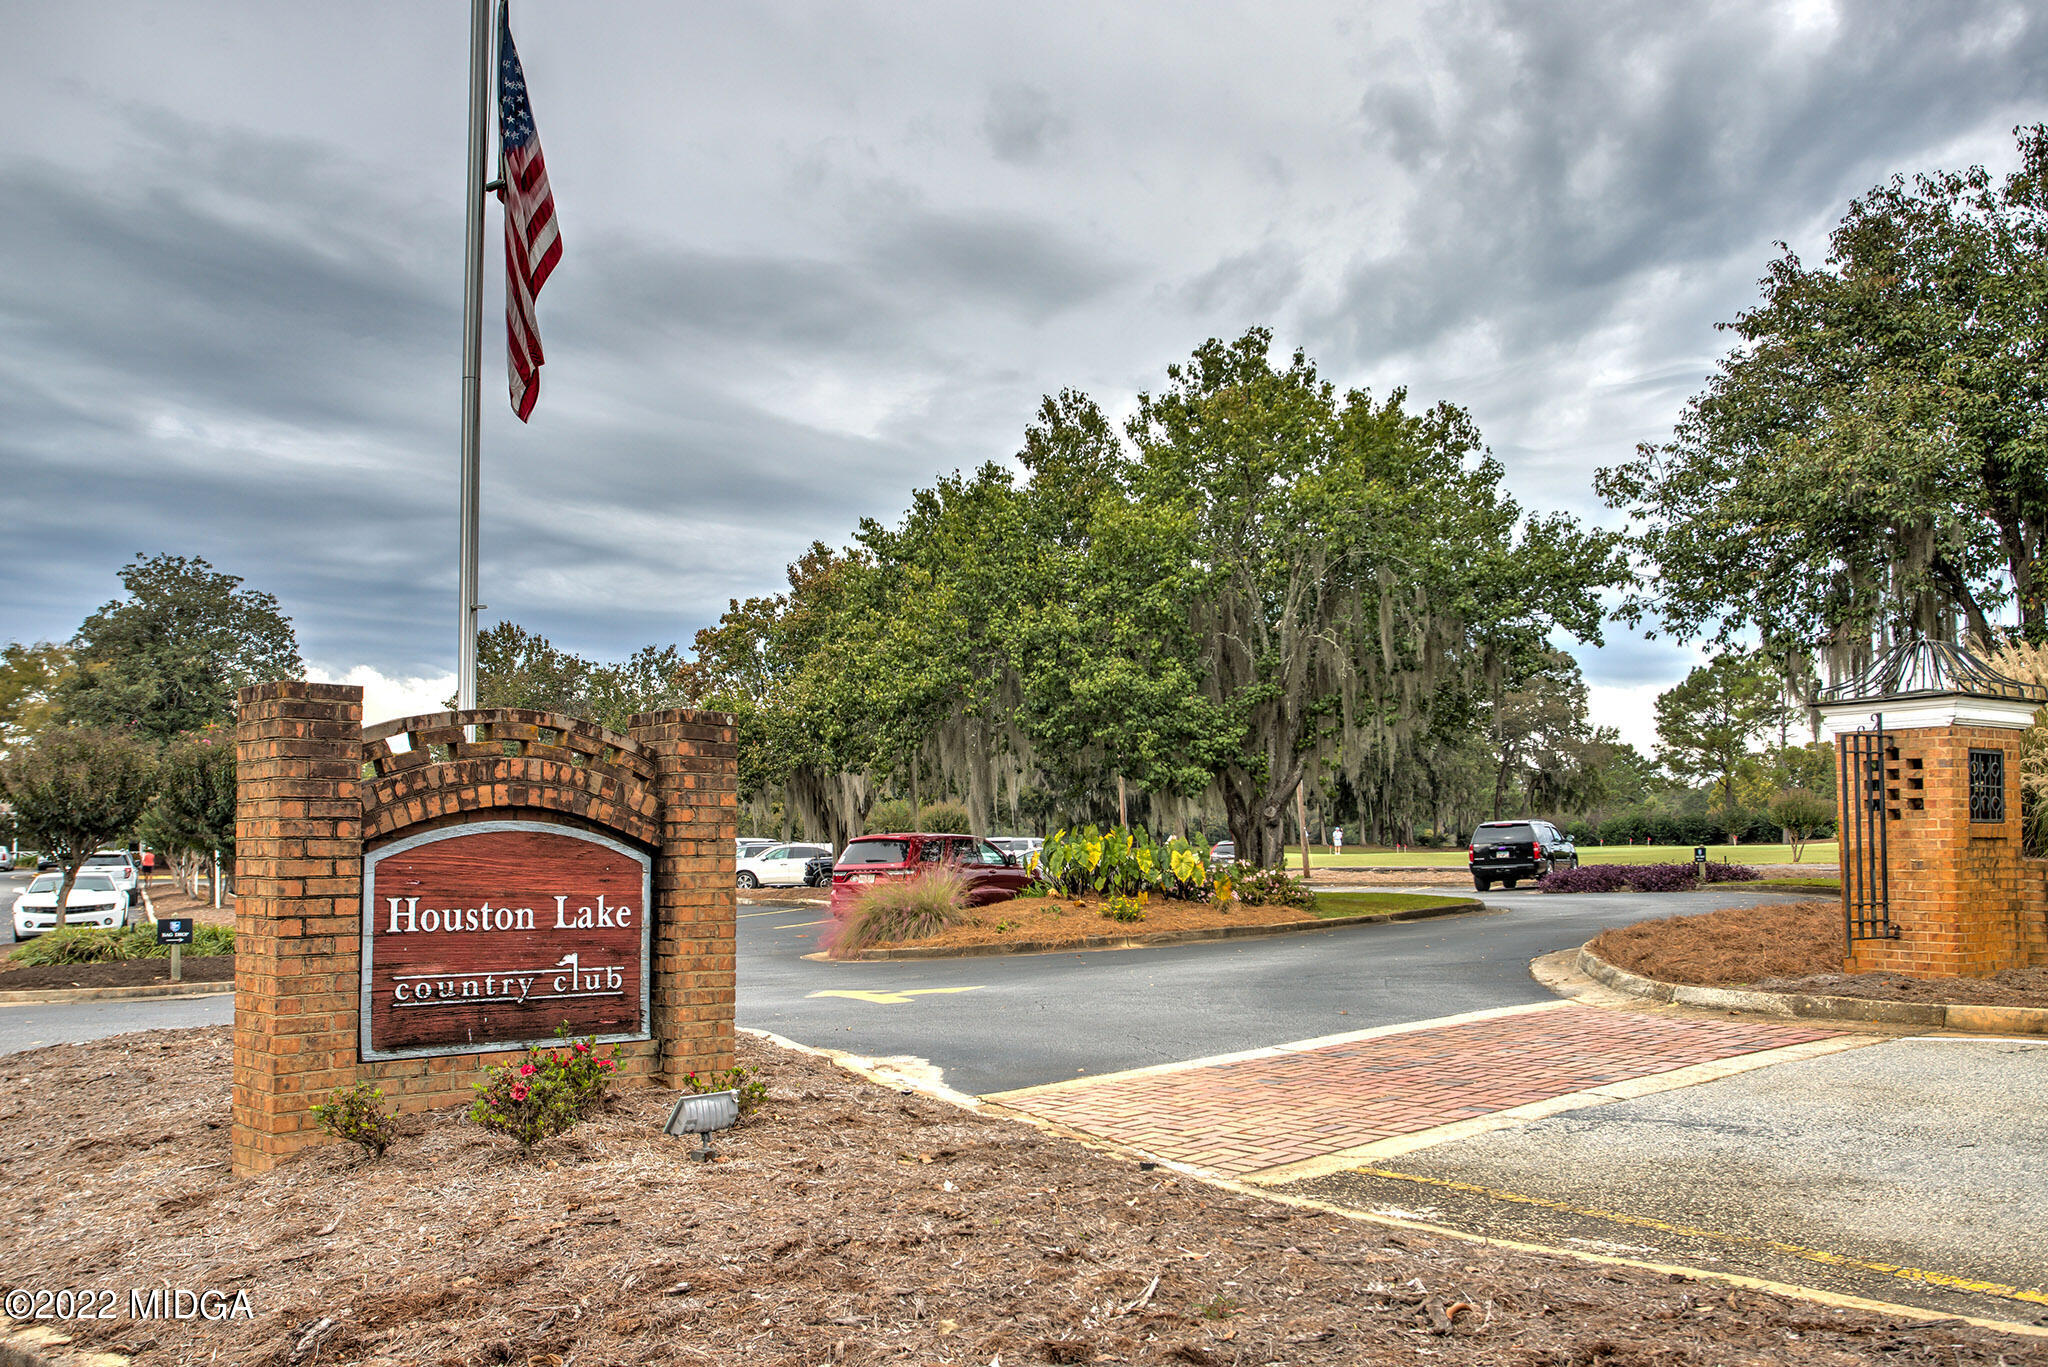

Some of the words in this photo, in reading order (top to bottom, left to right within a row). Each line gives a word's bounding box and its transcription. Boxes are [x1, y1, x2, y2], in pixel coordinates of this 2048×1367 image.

[386, 896, 536, 933] Houston
[553, 894, 632, 929] Lake
[394, 974, 535, 1004] country
[553, 952, 623, 992] club
